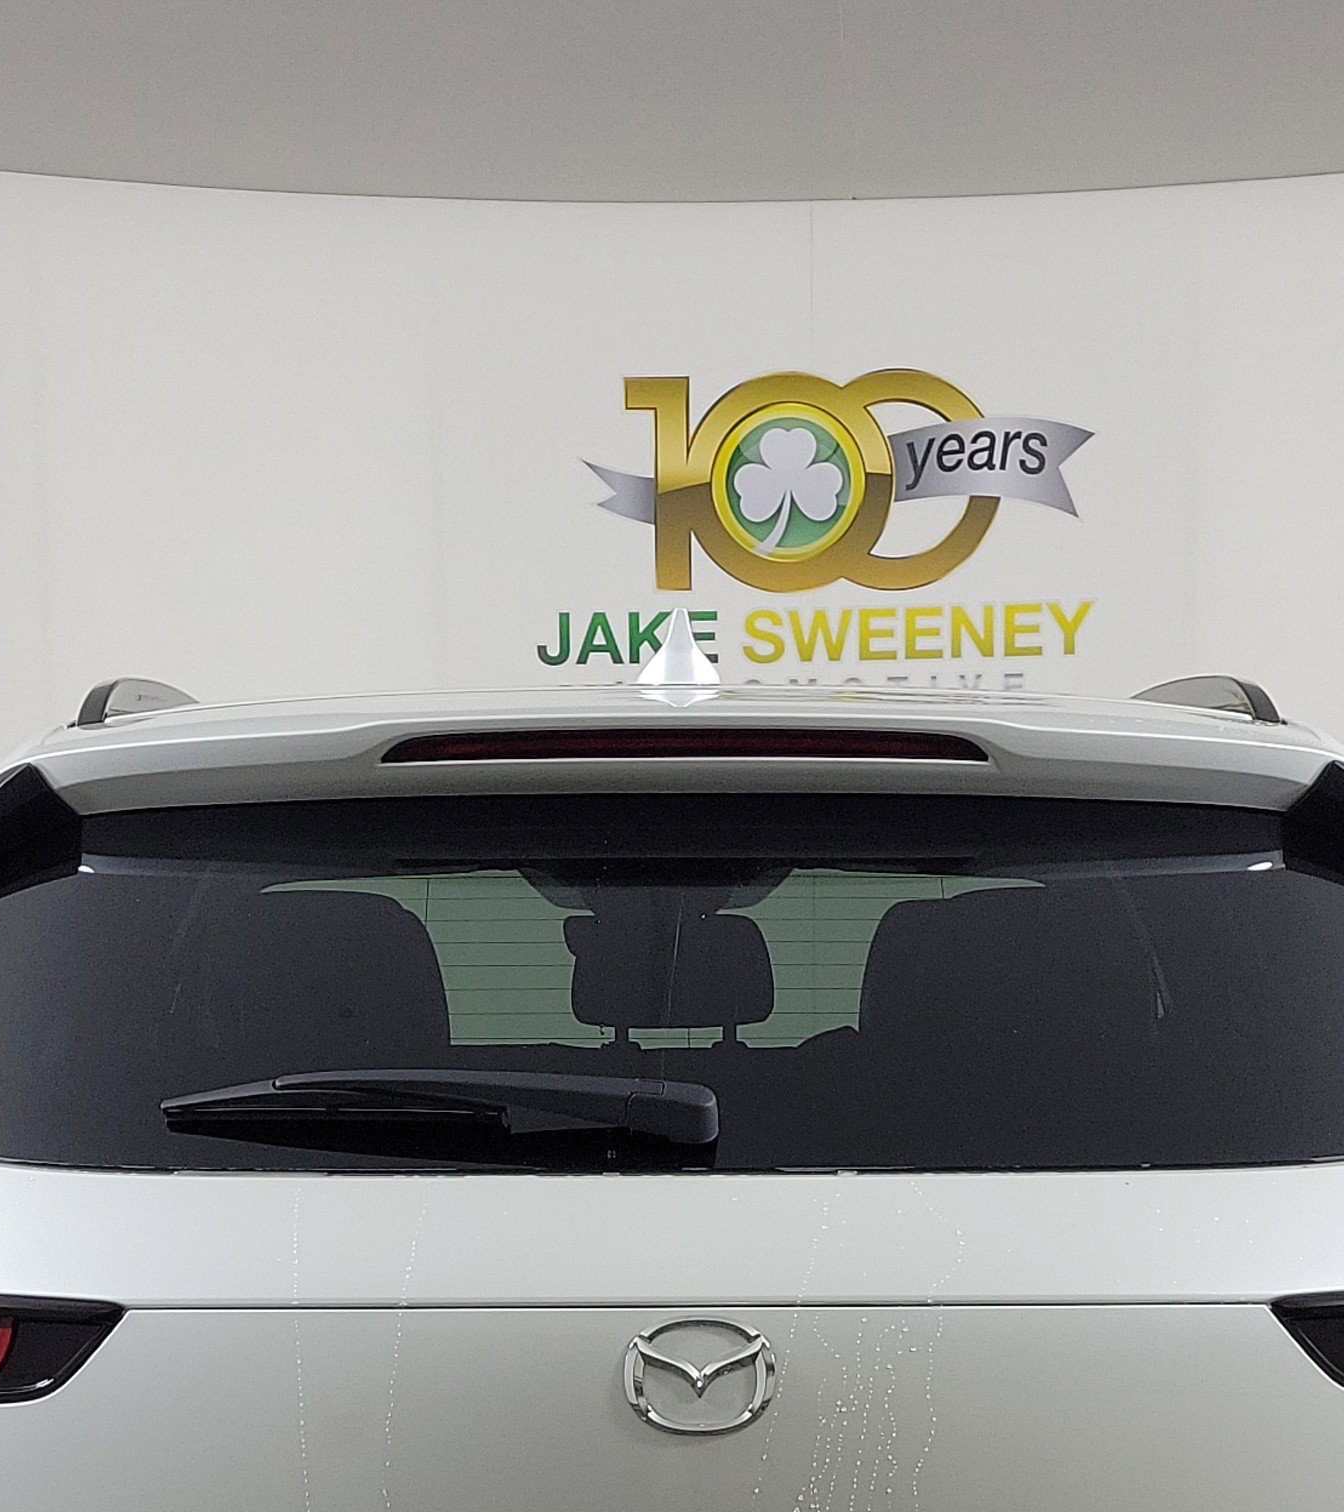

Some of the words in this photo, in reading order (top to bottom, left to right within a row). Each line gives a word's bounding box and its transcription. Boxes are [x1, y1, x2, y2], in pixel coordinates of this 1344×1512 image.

[623, 368, 1000, 592] 100
[905, 424, 1048, 490] years
[742, 600, 1094, 665] SWEENEY
